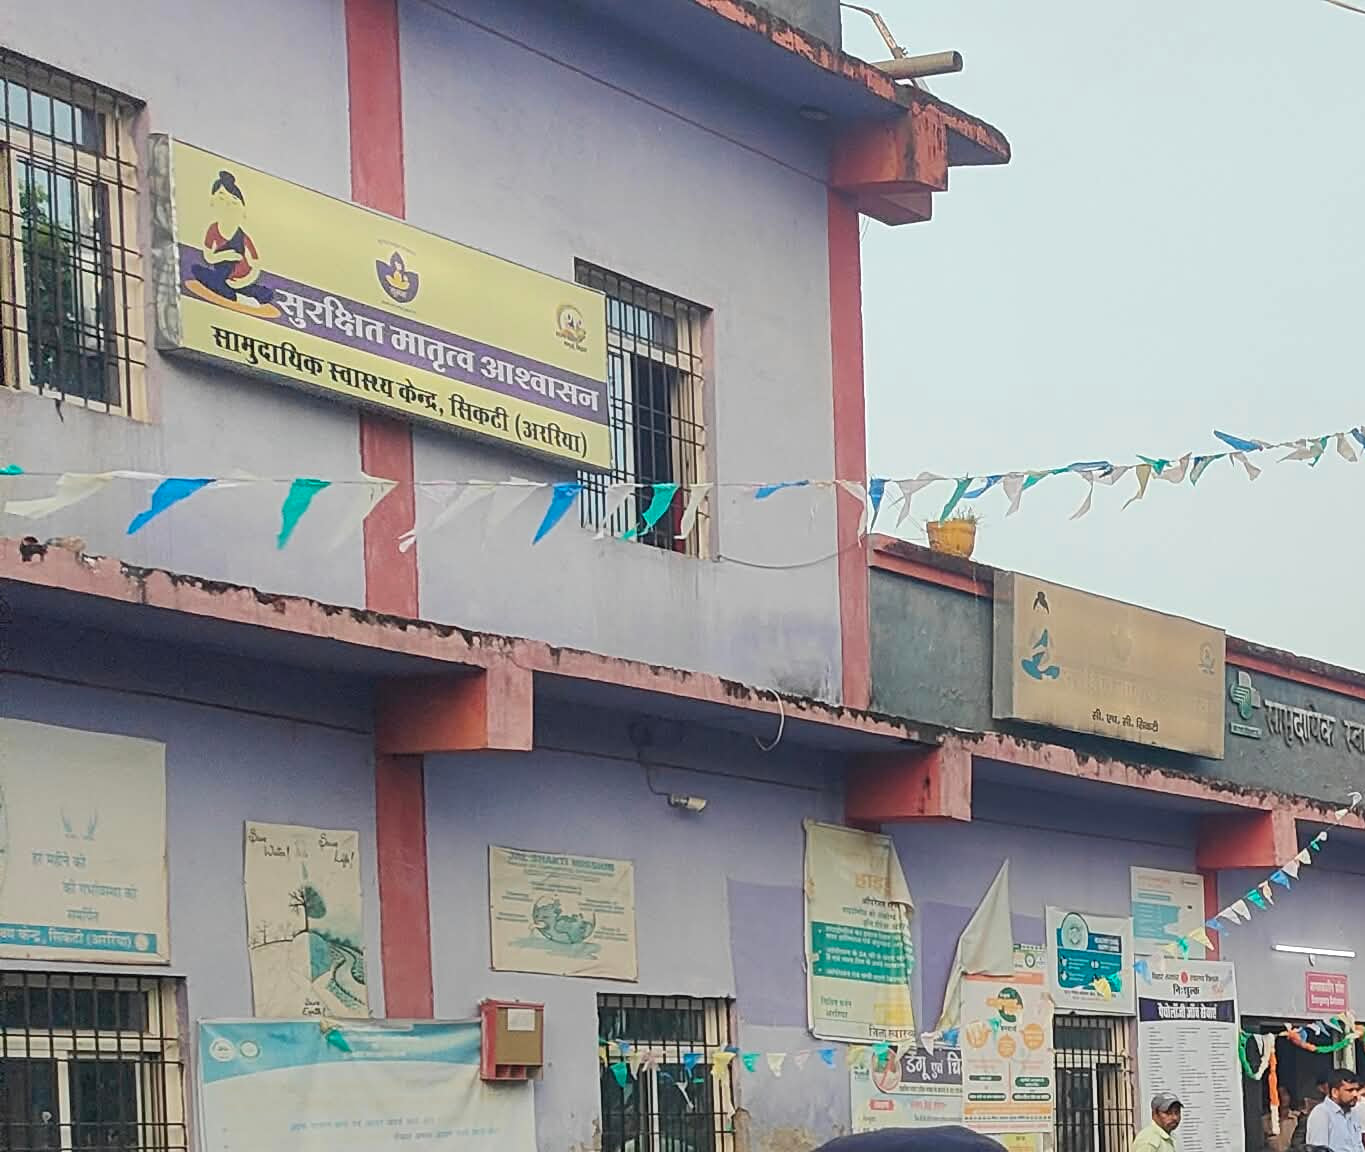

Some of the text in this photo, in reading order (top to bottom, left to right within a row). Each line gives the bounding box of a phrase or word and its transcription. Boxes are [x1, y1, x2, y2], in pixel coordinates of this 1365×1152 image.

[210, 325, 325, 375] सामुदायिक
[327, 361, 396, 399] स्वास्थ्य
[447, 393, 510, 432] सिकटी
[514, 412, 588, 458] (अररिया)
[275, 288, 600, 412] सुरक्षित मातृत्व आश्वासन
[946, 1051, 961, 1076] चि
